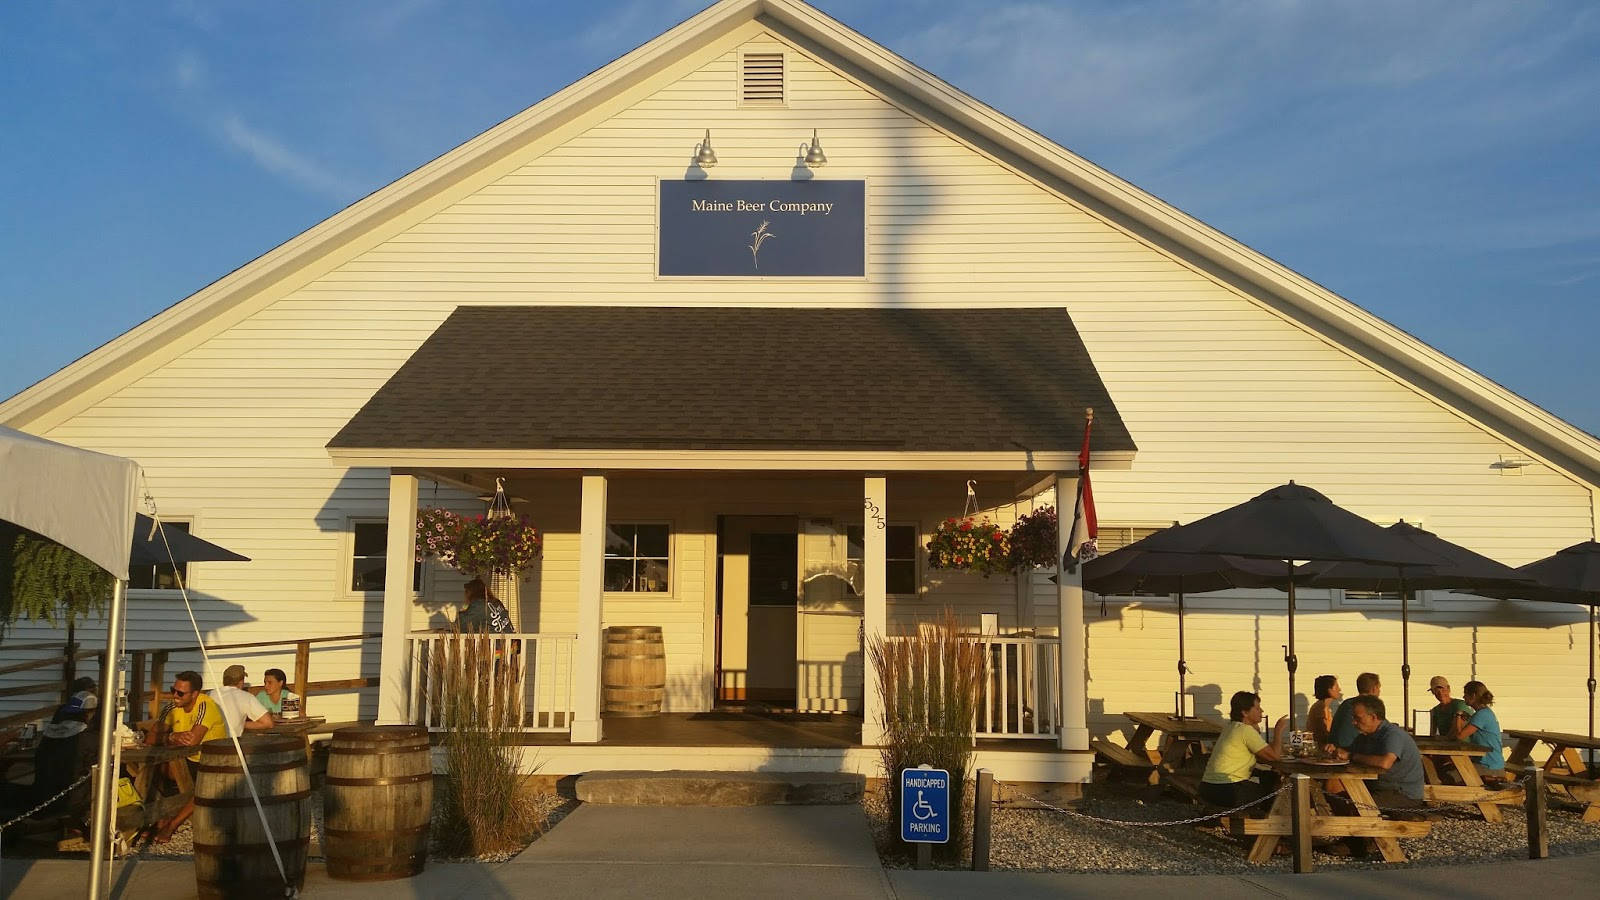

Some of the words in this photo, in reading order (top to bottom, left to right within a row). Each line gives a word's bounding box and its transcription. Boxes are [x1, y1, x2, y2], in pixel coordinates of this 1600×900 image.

[692, 199, 734, 211] Maine
[737, 199, 766, 211] Beer
[769, 199, 833, 215] Company
[864, 497, 886, 530] 525
[1291, 734, 1302, 744] 25
[905, 778, 946, 789] HANDICAPPED
[909, 822, 941, 834] PARKING
